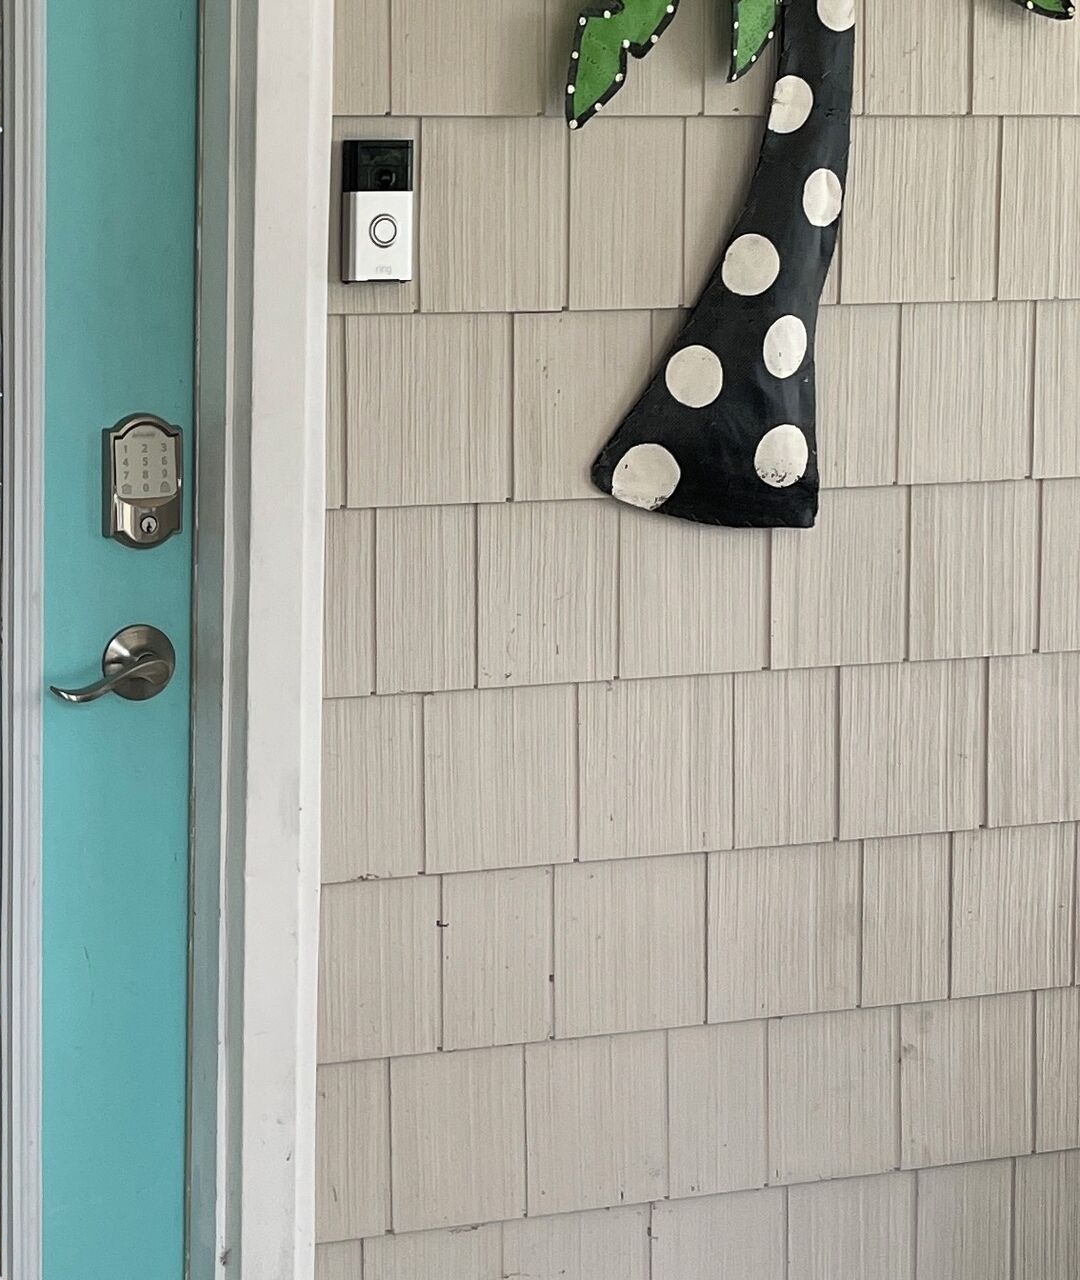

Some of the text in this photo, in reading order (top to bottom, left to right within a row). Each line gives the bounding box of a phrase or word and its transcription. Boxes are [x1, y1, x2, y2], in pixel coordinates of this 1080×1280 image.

[375, 263, 392, 275] ring
[123, 442, 167, 454] 1 2 3
[122, 455, 168, 467] 4 5 6
[123, 468, 168, 480] 7 8 9
[142, 483, 149, 492] 0
